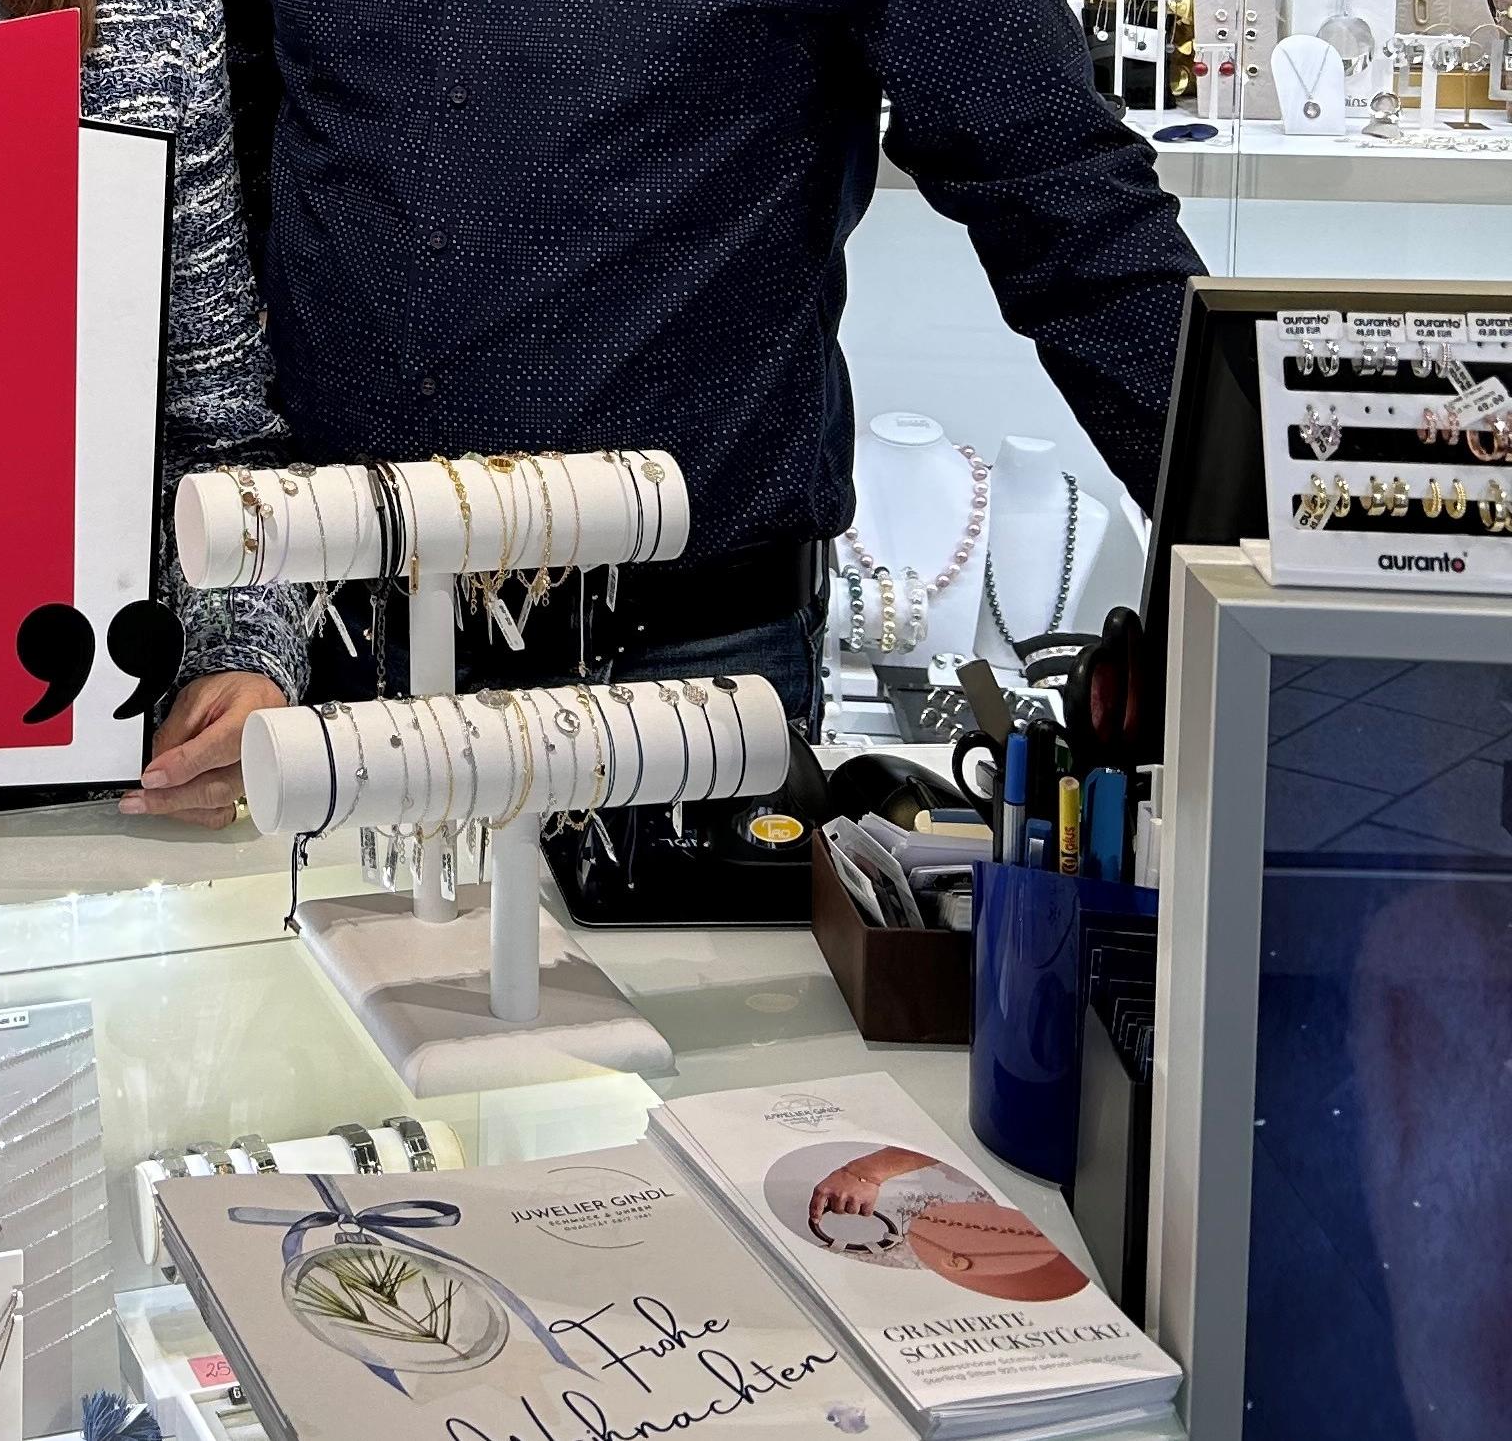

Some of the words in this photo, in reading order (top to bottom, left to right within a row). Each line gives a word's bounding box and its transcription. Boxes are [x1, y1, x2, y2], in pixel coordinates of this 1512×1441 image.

[1283, 314, 1330, 326] auranto
[1353, 317, 1401, 328] auranto
[1413, 317, 1461, 329] auranto
[1378, 552, 1467, 572] auranto
[510, 1200, 607, 1223] JUWELIER
[610, 1188, 675, 1207] GINDL
[548, 1213, 600, 1227] SCHMUCK
[883, 1311, 1034, 1343] GRAVIERTE
[549, 1296, 731, 1394] Frohe
[899, 1322, 1130, 1364] SCHMUCKSTÜCKE
[205, 1361, 231, 1378] 25
